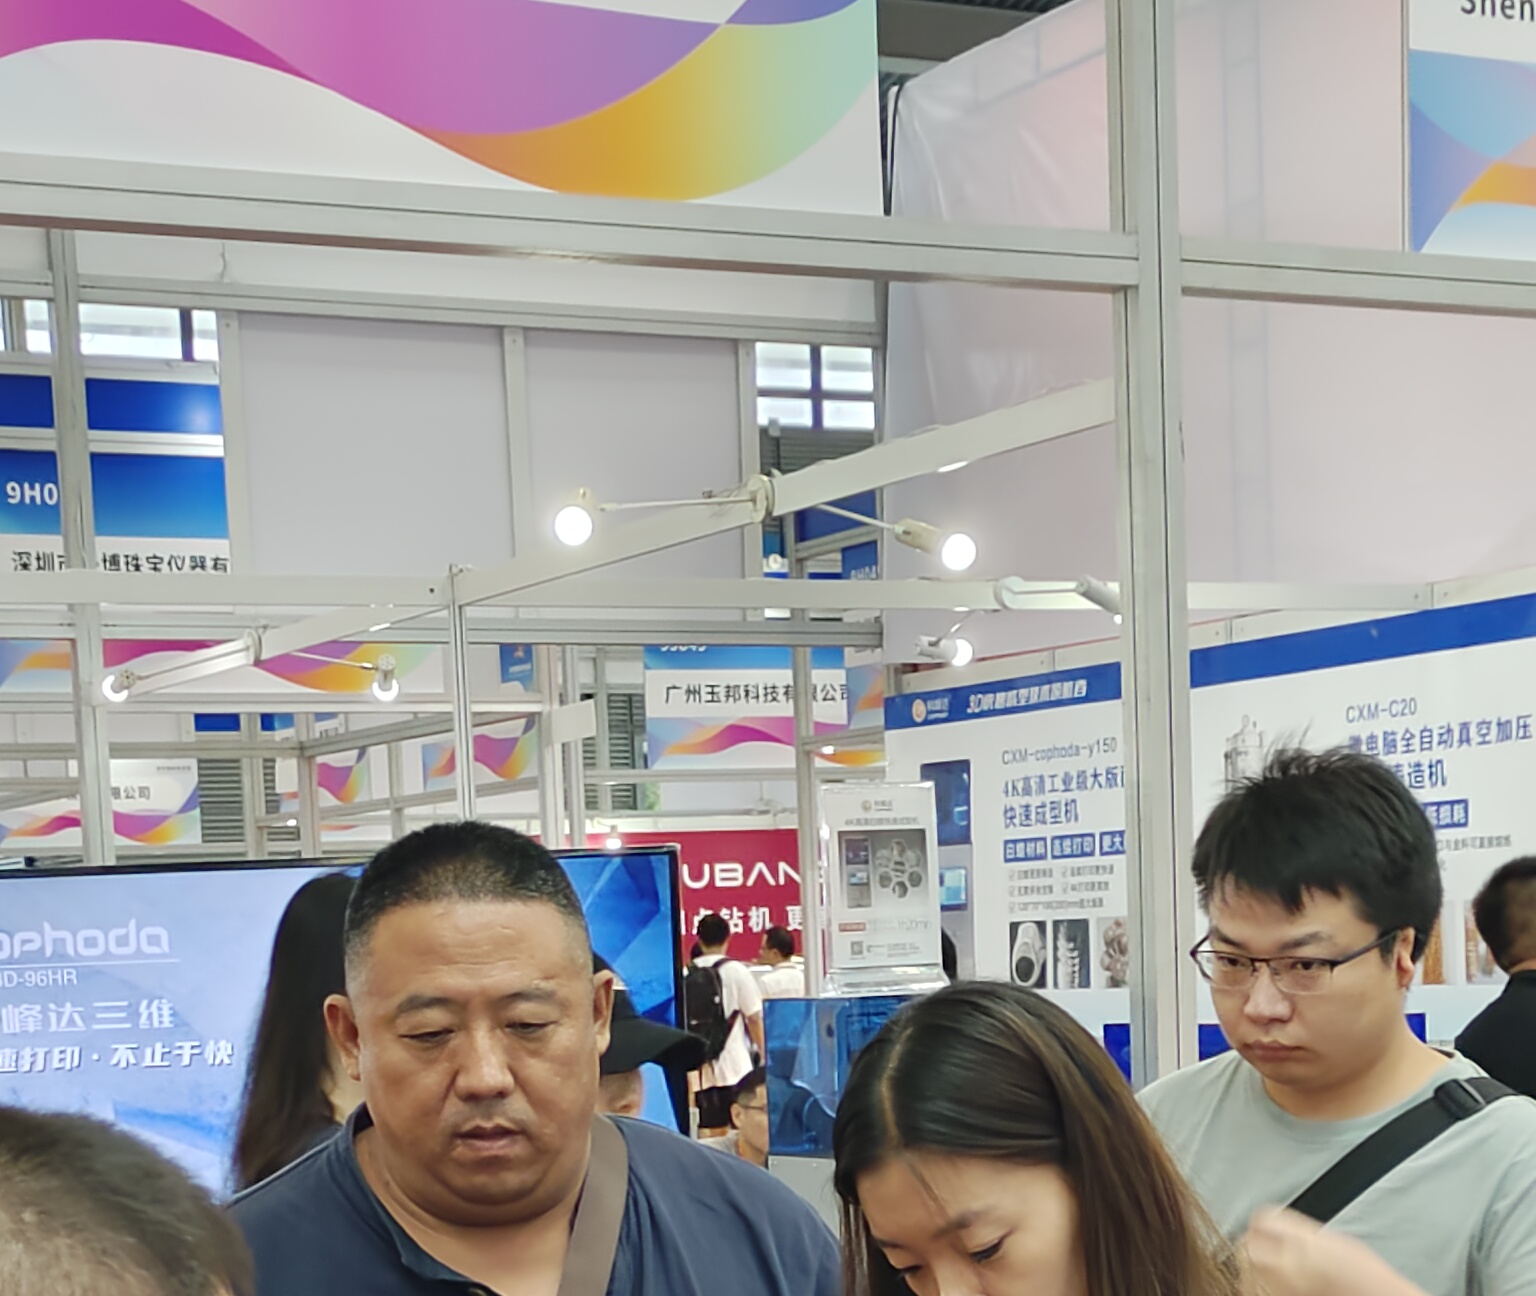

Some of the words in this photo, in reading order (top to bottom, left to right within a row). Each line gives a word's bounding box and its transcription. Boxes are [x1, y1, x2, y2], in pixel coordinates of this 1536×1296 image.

[1345, 697, 1417, 723] CXM-C20
[1348, 714, 1534, 757] 微电脑全自动真空加压
[1004, 798, 1079, 830] 快速成型机
[681, 906, 773, 937] 点钻机
